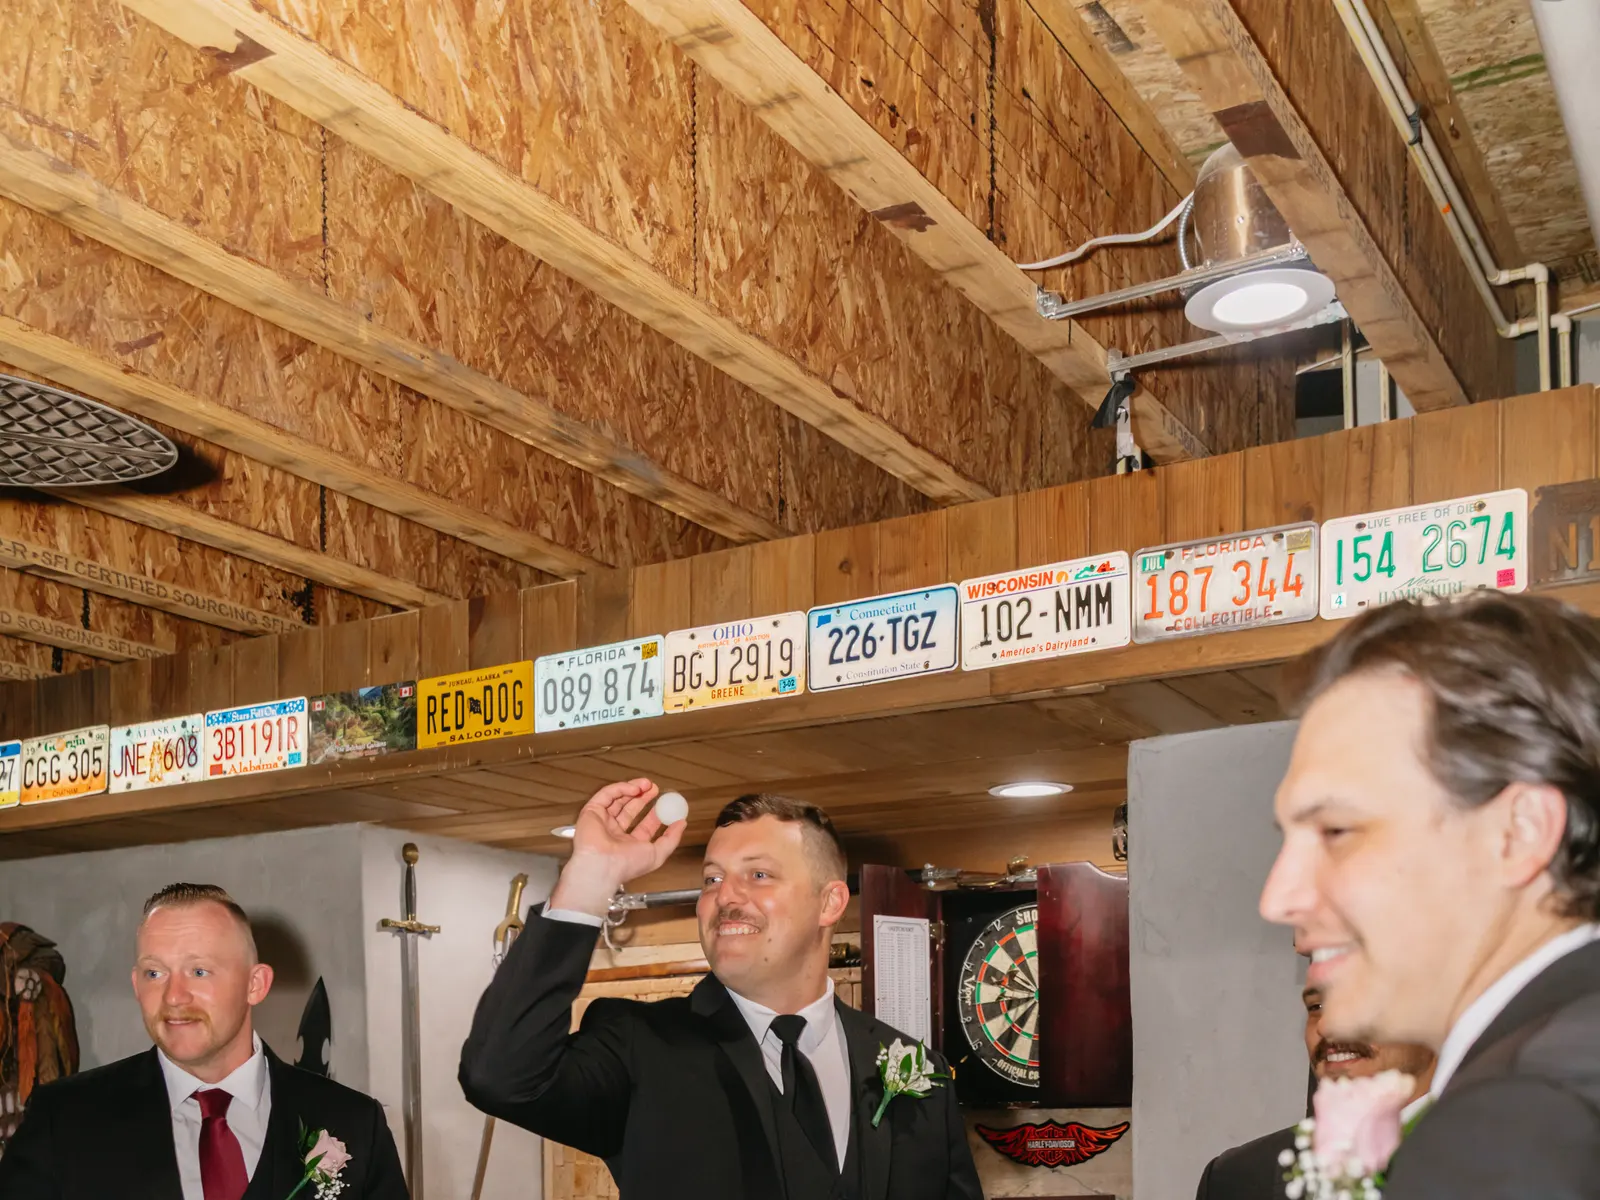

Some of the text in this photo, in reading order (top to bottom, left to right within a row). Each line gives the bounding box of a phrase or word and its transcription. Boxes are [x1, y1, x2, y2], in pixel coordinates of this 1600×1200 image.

[1367, 503, 1475, 529] LIVE FREE OR DIE
[1181, 536, 1266, 560] FLORIDA
[1336, 511, 1516, 586] 154 2674
[1144, 555, 1163, 571] JUL
[74, 561, 168, 598] CERTIFIED
[173, 589, 258, 625] SOURCING
[967, 571, 1054, 599] WISCONSIN
[1144, 553, 1304, 621] 187 344
[849, 602, 917, 621] Connecticut
[1335, 595, 1343, 605] 4
[1173, 605, 1273, 632] COLLECTIBLE
[17, 615, 104, 648] SOURCING
[697, 640, 730, 649] BIRTHPLACE
[745, 633, 770, 641] AVIATION
[713, 623, 753, 640] OHIO
[568, 648, 626, 668] FLORIDA
[1000, 636, 1089, 659] America's Dairyland
[673, 638, 793, 693] BGJ 2919
[846, 661, 921, 680] Constitution State
[476, 673, 501, 683] ALASKA
[543, 661, 655, 715] 089 874
[711, 685, 745, 700] GREENE
[427, 679, 523, 735] RED DOG
[573, 706, 625, 724] ANTIQUE
[137, 725, 177, 738] ALASKA
[213, 716, 298, 762] 3B1191R
[449, 727, 502, 743] SALOON
[24, 746, 102, 789] CGG 305
[113, 735, 198, 778] JNE 608
[228, 760, 279, 775] Alabama
